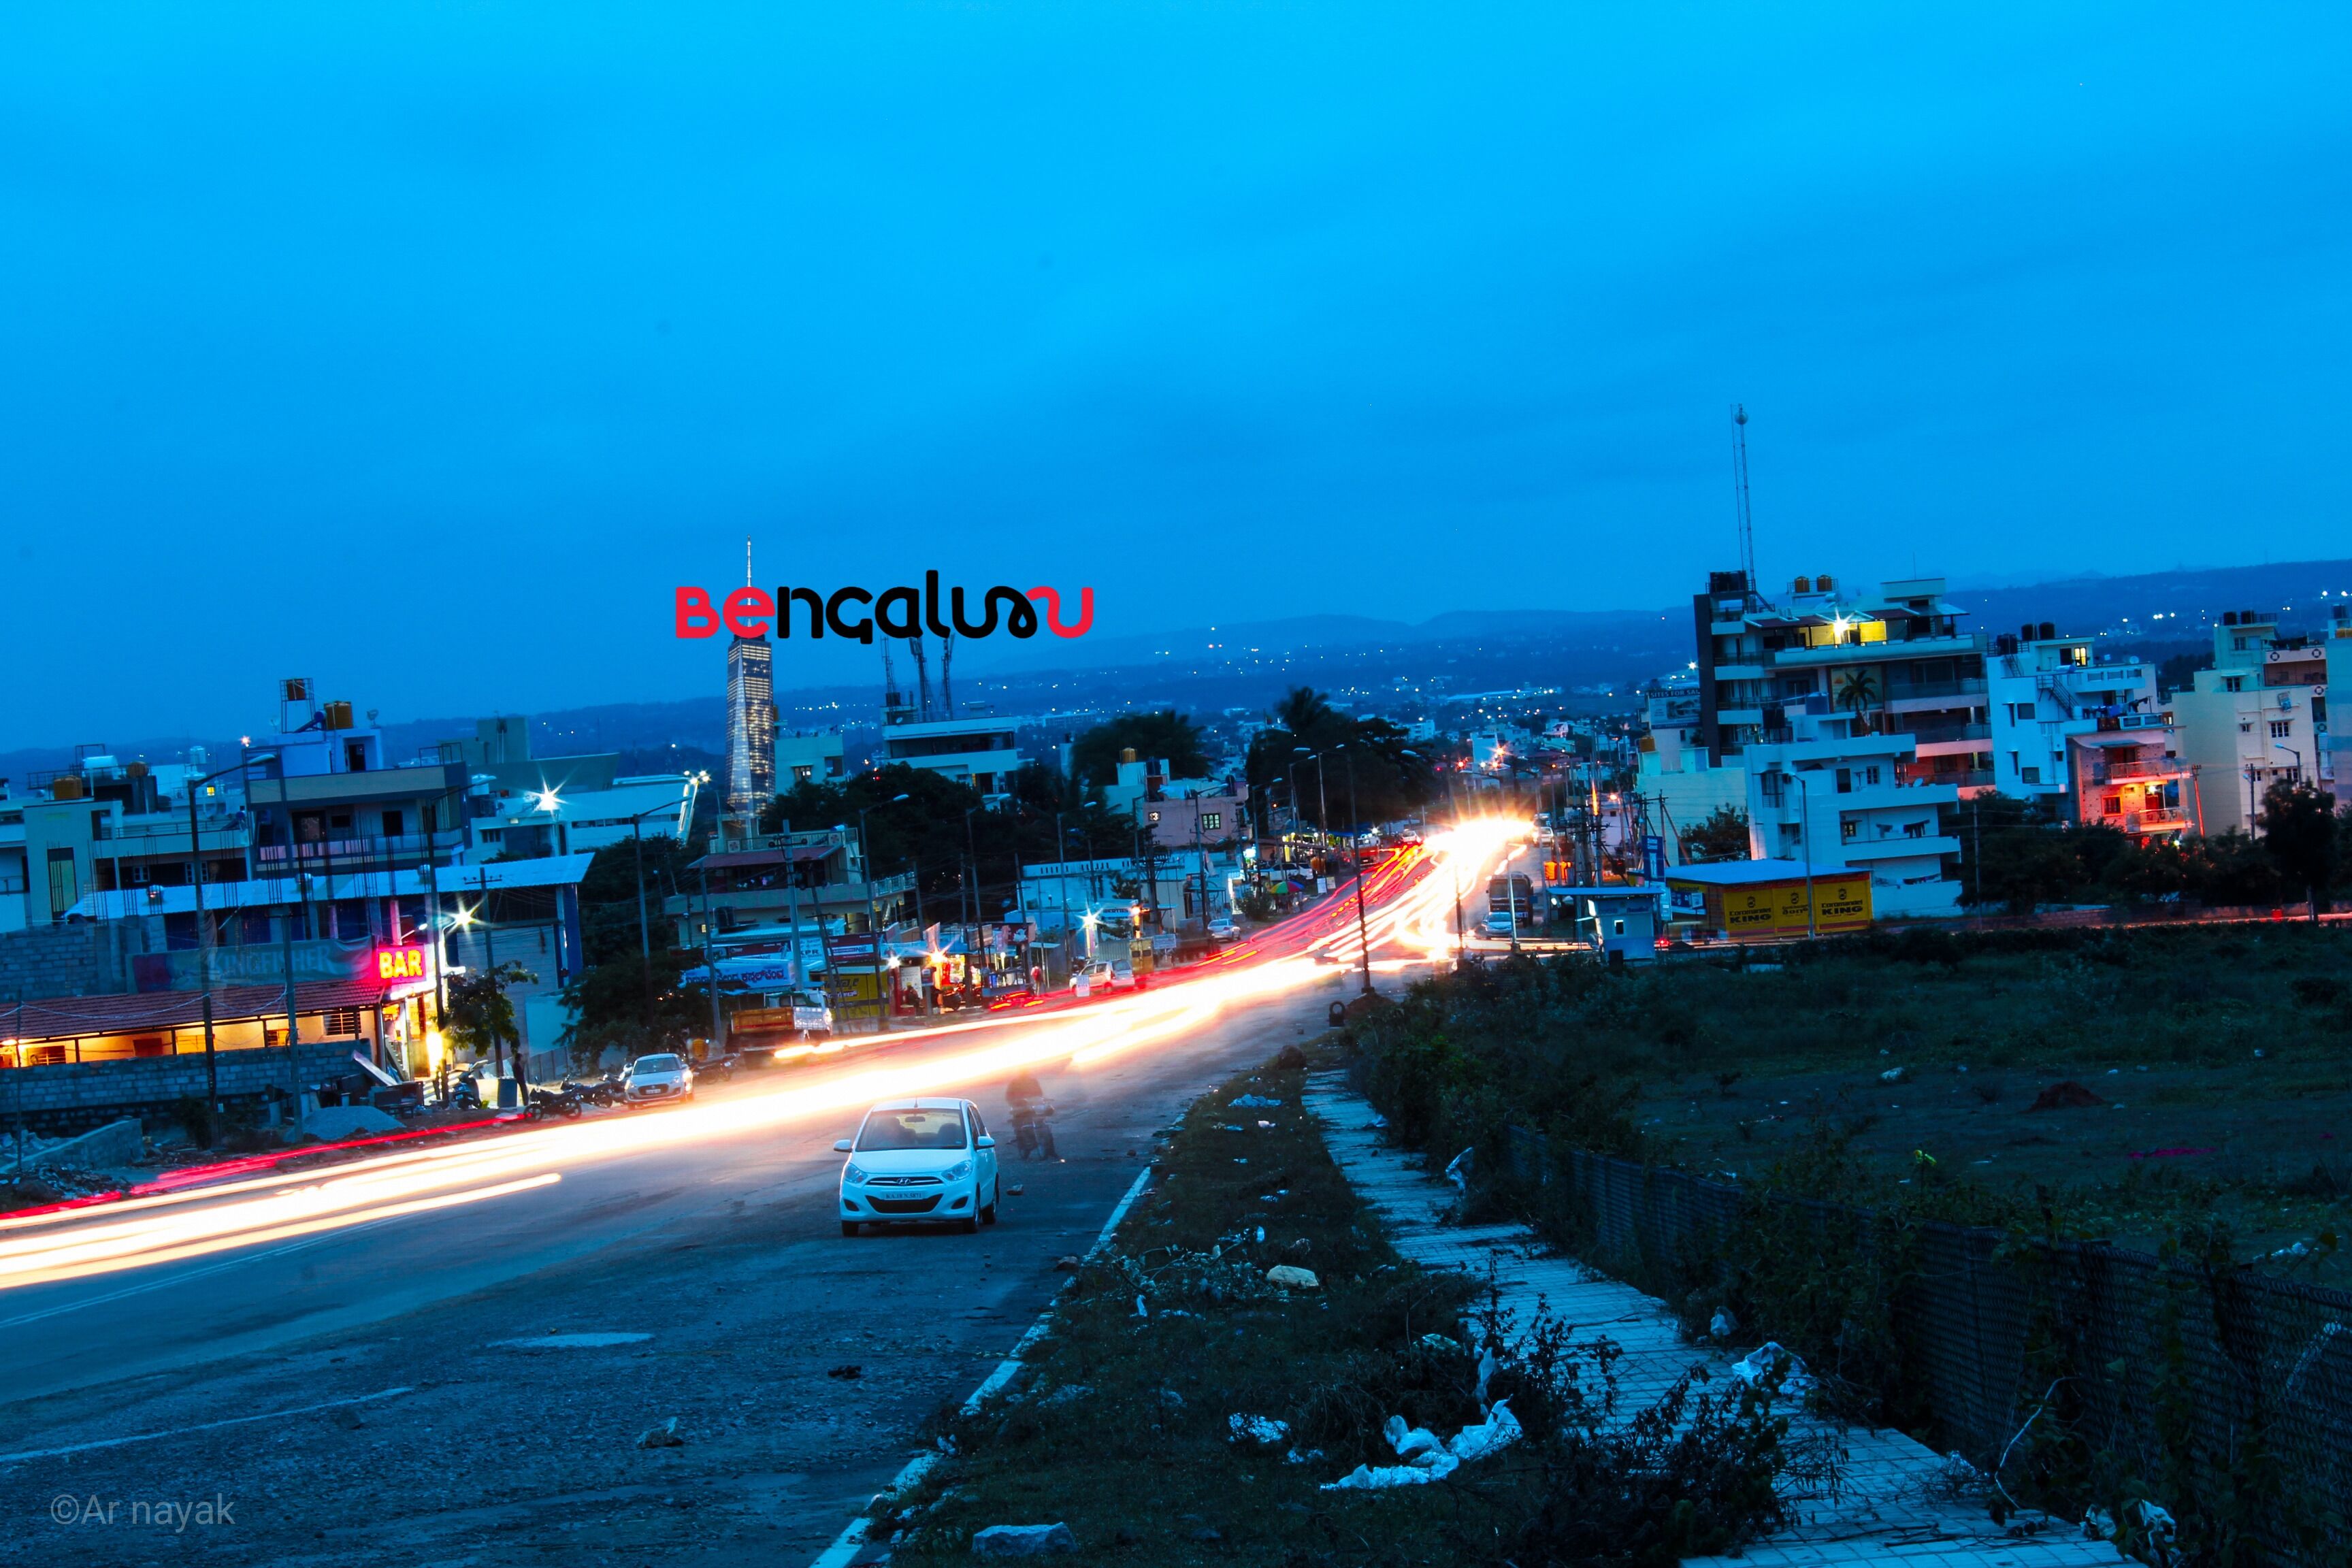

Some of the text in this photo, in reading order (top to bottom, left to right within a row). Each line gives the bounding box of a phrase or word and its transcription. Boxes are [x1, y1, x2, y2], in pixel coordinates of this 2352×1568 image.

[1730, 914, 1771, 924] KING
[1822, 906, 1863, 915] KING
[210, 945, 338, 975] KINGFISHER
[378, 949, 423, 979] BAR
